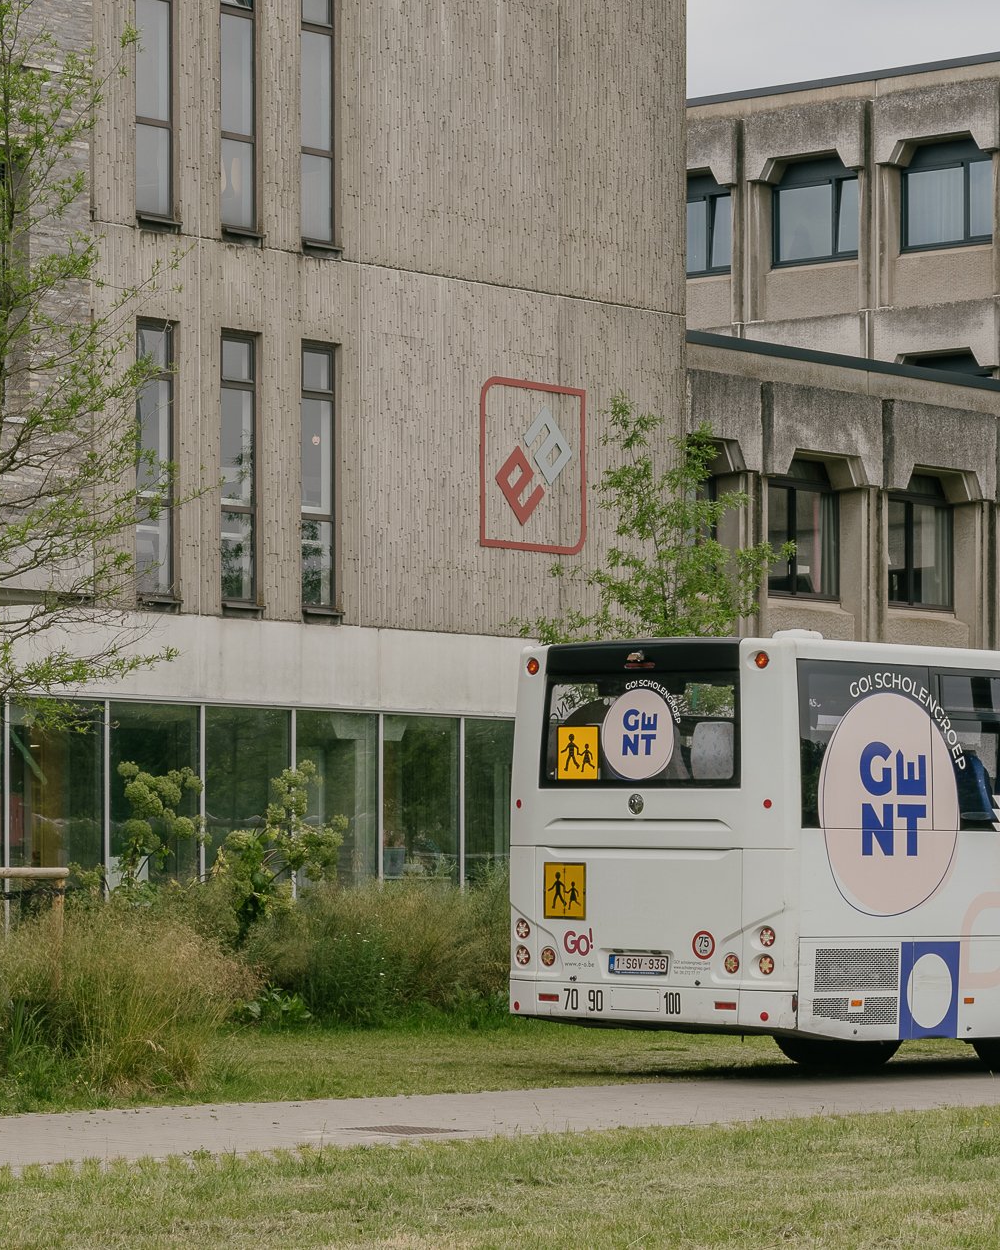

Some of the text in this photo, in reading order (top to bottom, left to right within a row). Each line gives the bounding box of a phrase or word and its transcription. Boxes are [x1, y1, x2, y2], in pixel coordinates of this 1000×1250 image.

[625, 679, 682, 724] GO! SCHOLENGROEP
[849, 672, 967, 770] GO! SCHOLENGROEP
[698, 936, 710, 948] 75
[563, 988, 681, 1015] 70 90 100
